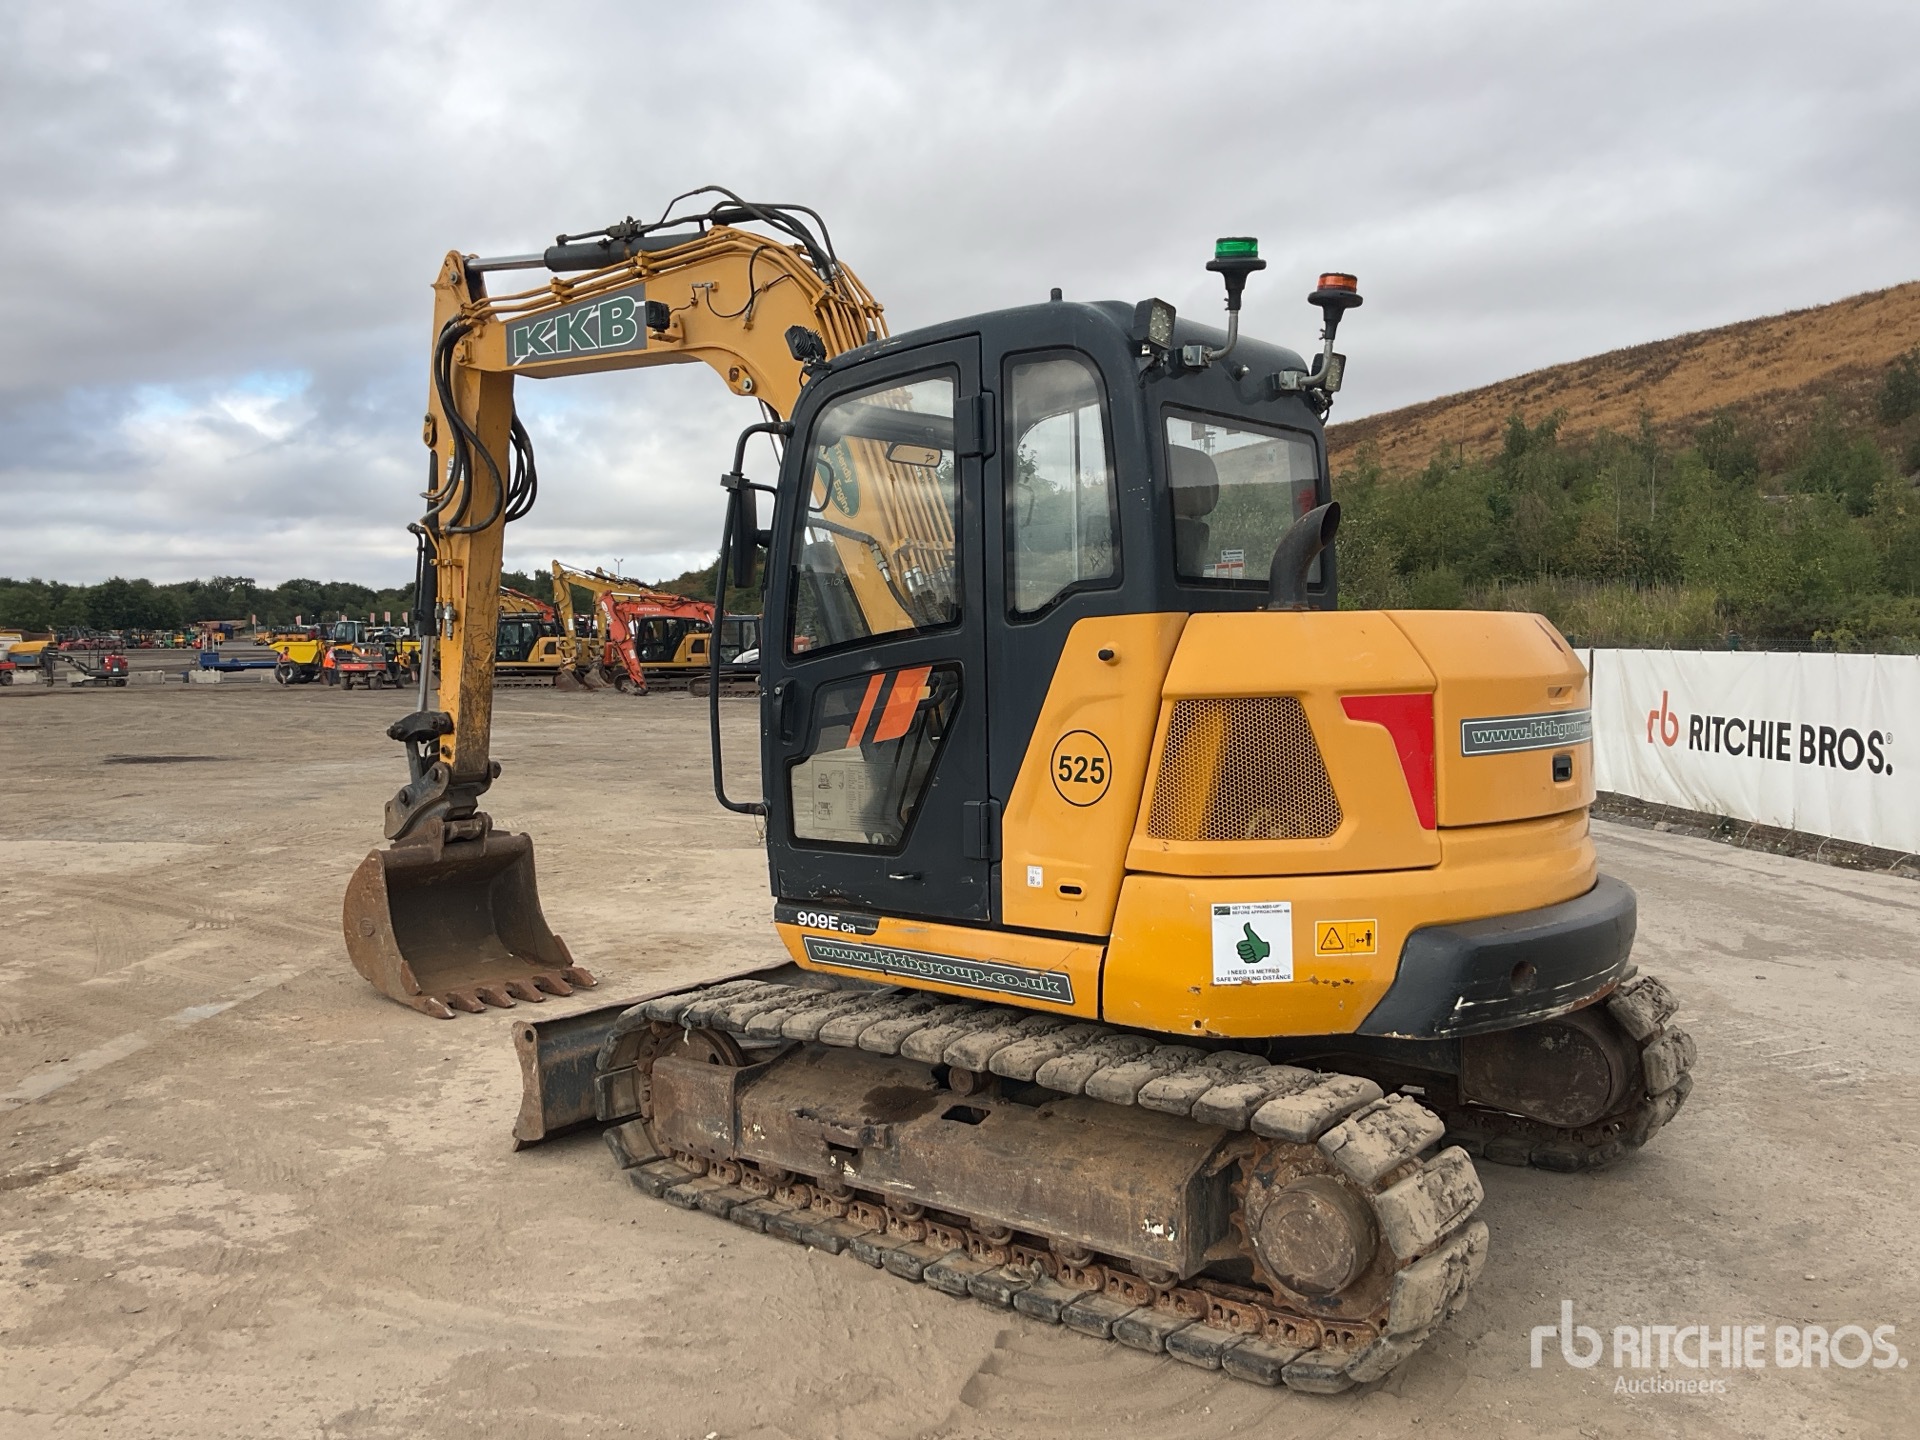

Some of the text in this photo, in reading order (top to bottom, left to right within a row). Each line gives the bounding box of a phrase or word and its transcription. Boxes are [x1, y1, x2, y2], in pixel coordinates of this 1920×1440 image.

[513, 295, 637, 358] KKB
[834, 443, 853, 484] Friendly
[833, 479, 850, 514] Engine
[1647, 690, 1680, 748] rb
[1688, 713, 1791, 762] RITCHIE
[1058, 755, 1105, 785] 525
[797, 910, 856, 934] 909E CR
[814, 944, 1060, 994] www.kkbgroup.co.uk
[1262, 973, 1291, 981] DISTANCE
